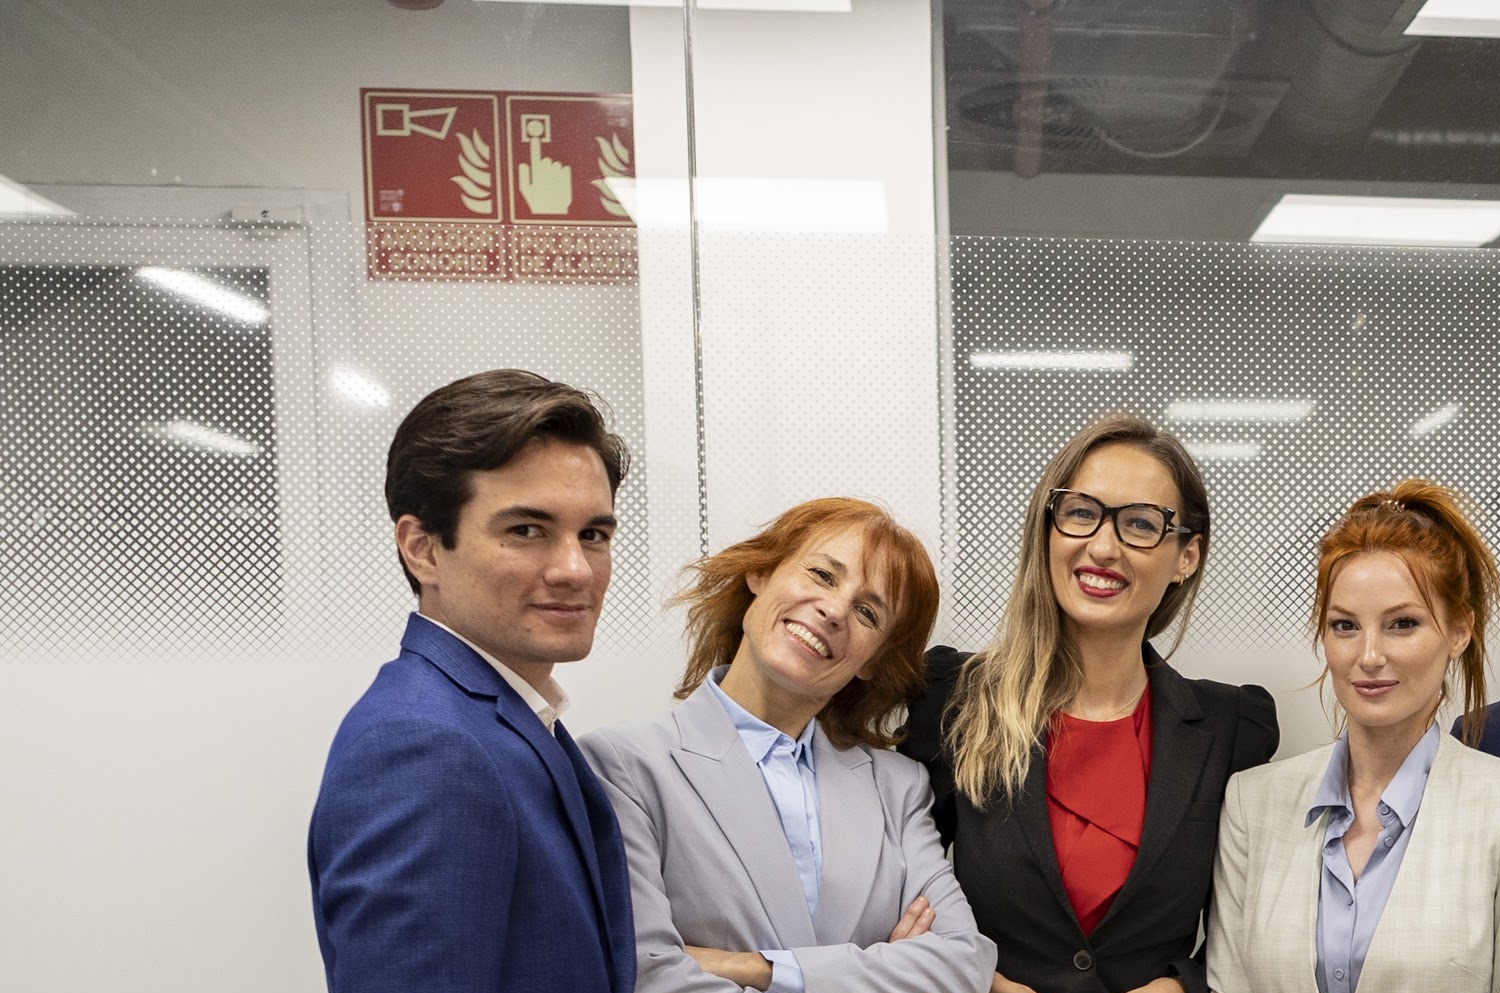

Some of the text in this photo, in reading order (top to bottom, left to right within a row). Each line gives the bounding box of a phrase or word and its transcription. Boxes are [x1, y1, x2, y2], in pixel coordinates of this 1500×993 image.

[381, 231, 493, 250] AVISADOR
[520, 234, 635, 255] PULSADOR
[389, 252, 487, 271] SONORO
[520, 256, 546, 273] DE
